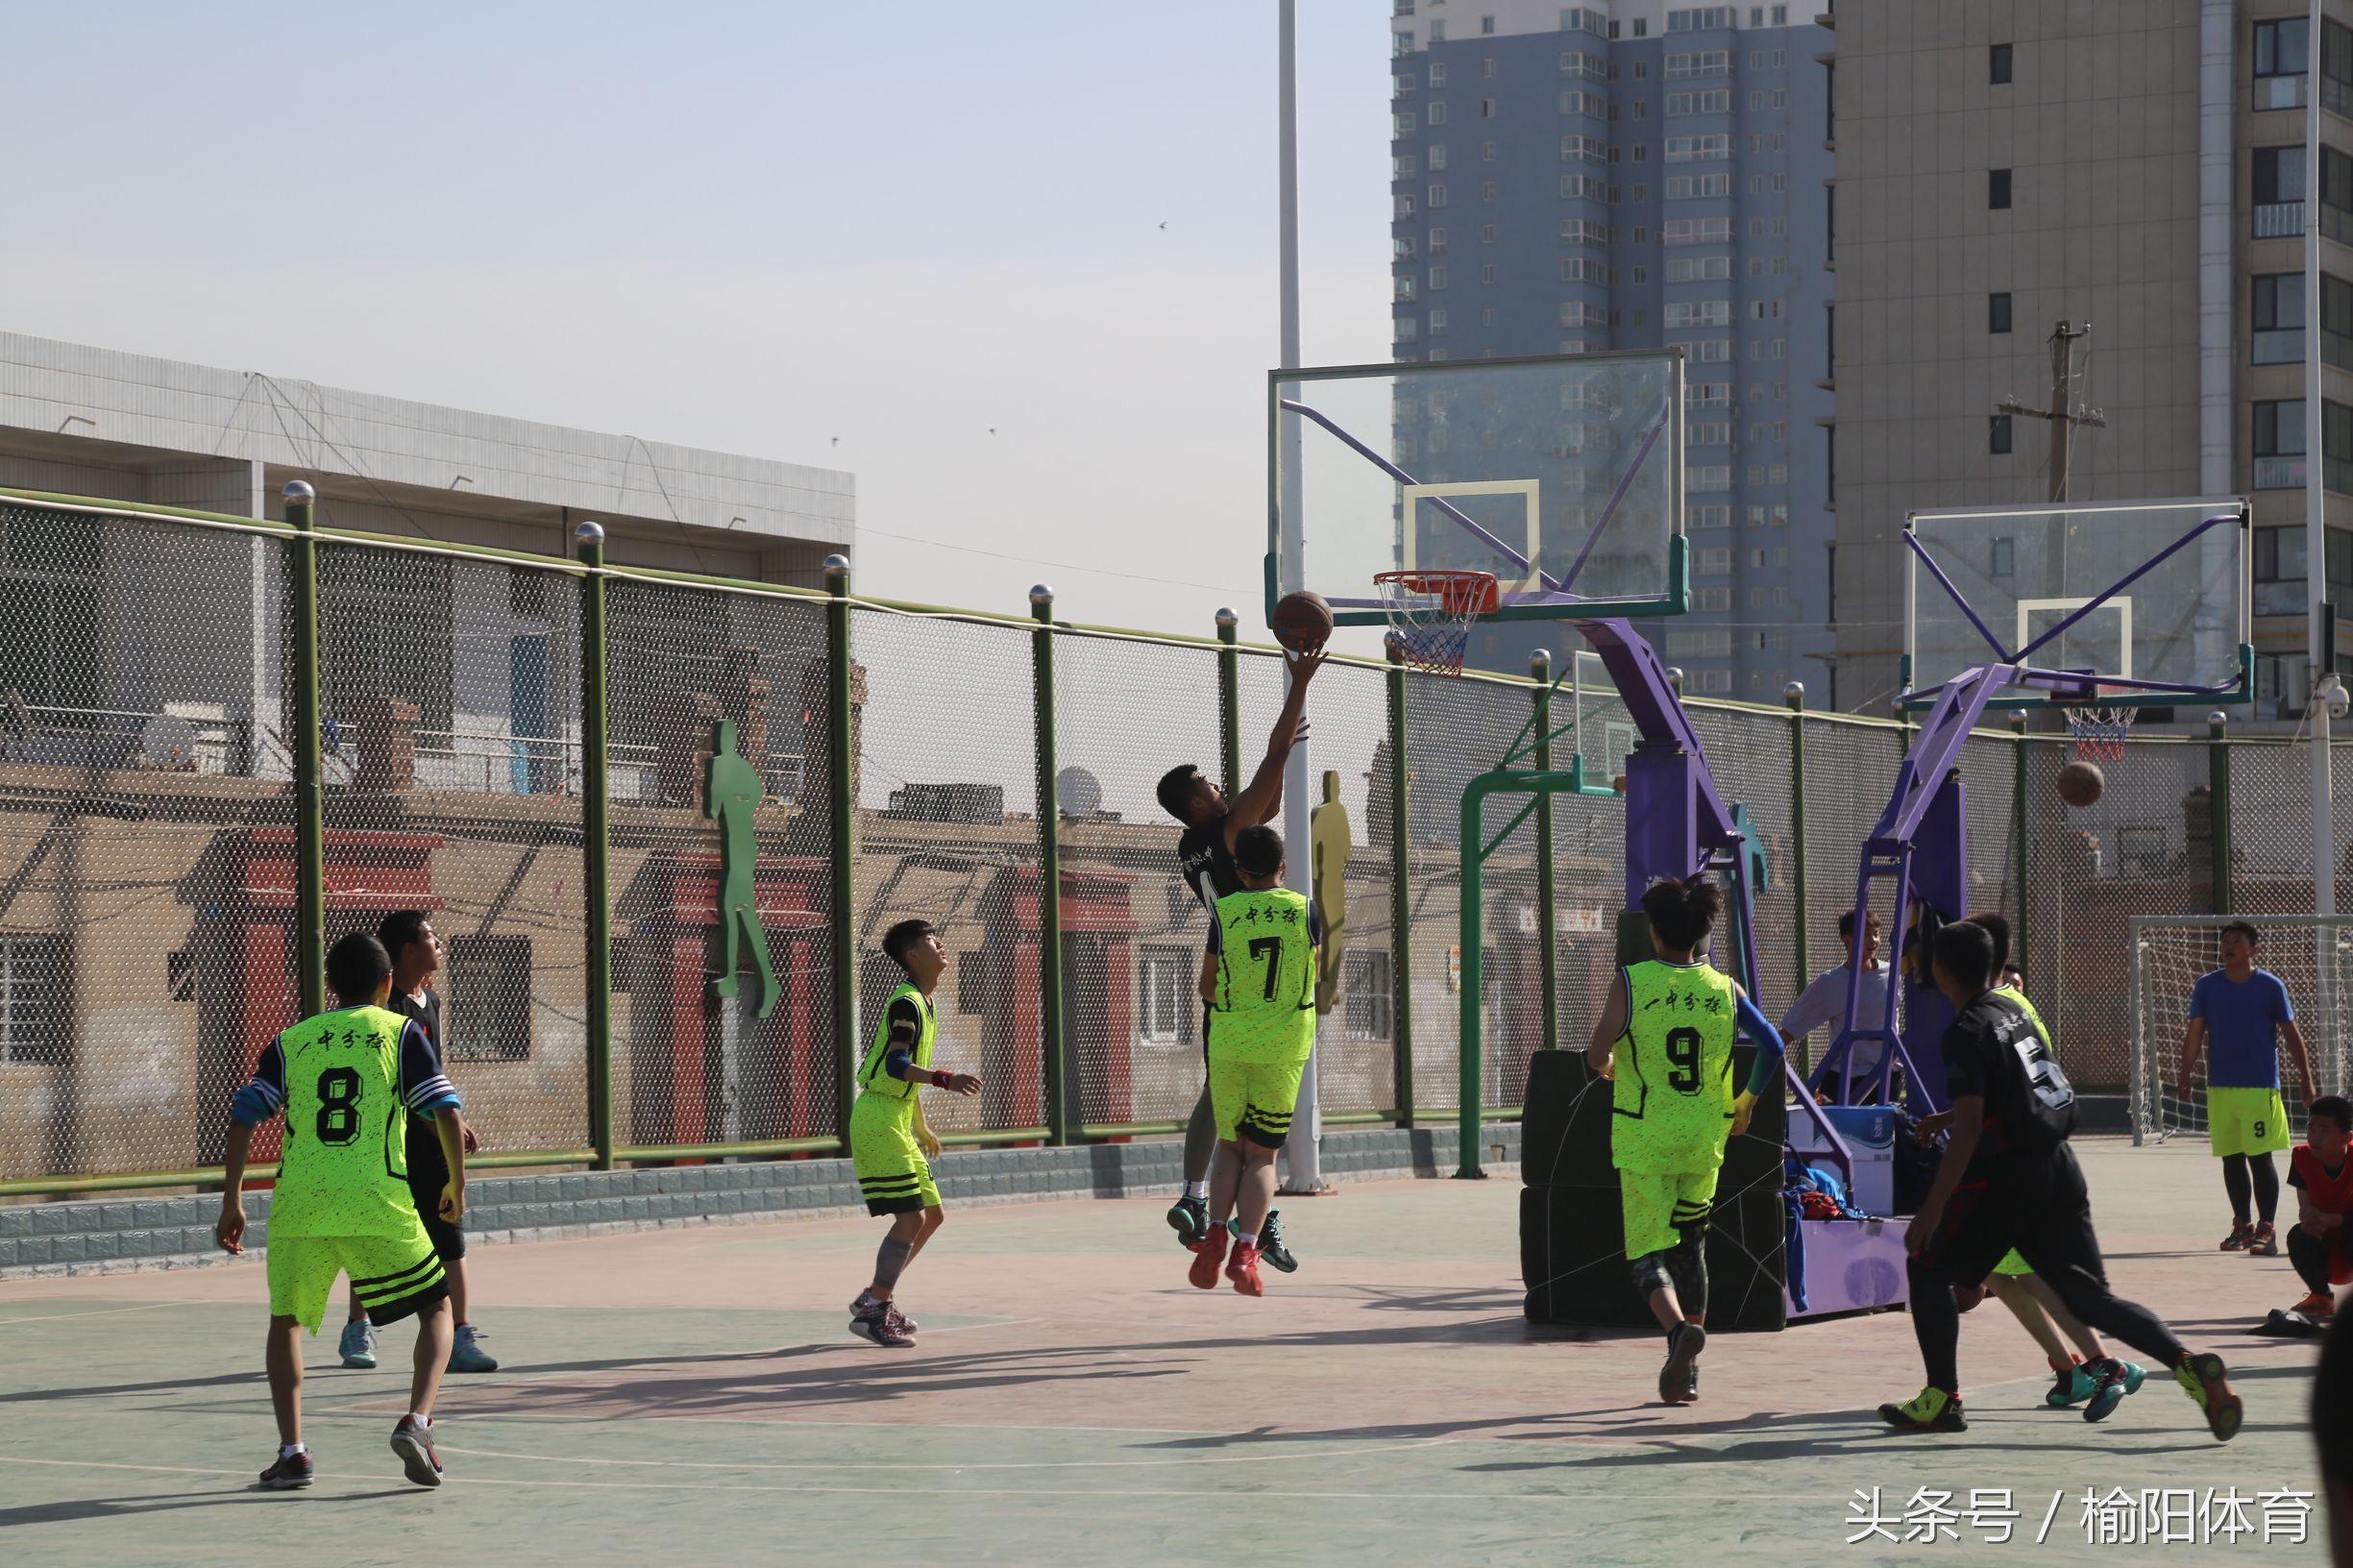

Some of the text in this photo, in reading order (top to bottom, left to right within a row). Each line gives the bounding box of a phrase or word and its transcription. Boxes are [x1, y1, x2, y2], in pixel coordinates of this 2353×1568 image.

[1248, 936, 1284, 1003] 7
[1666, 1027, 1703, 1097] 9
[2014, 1036, 2074, 1111] 5
[316, 1066, 363, 1146] 8
[2254, 1120, 2266, 1138] 9
